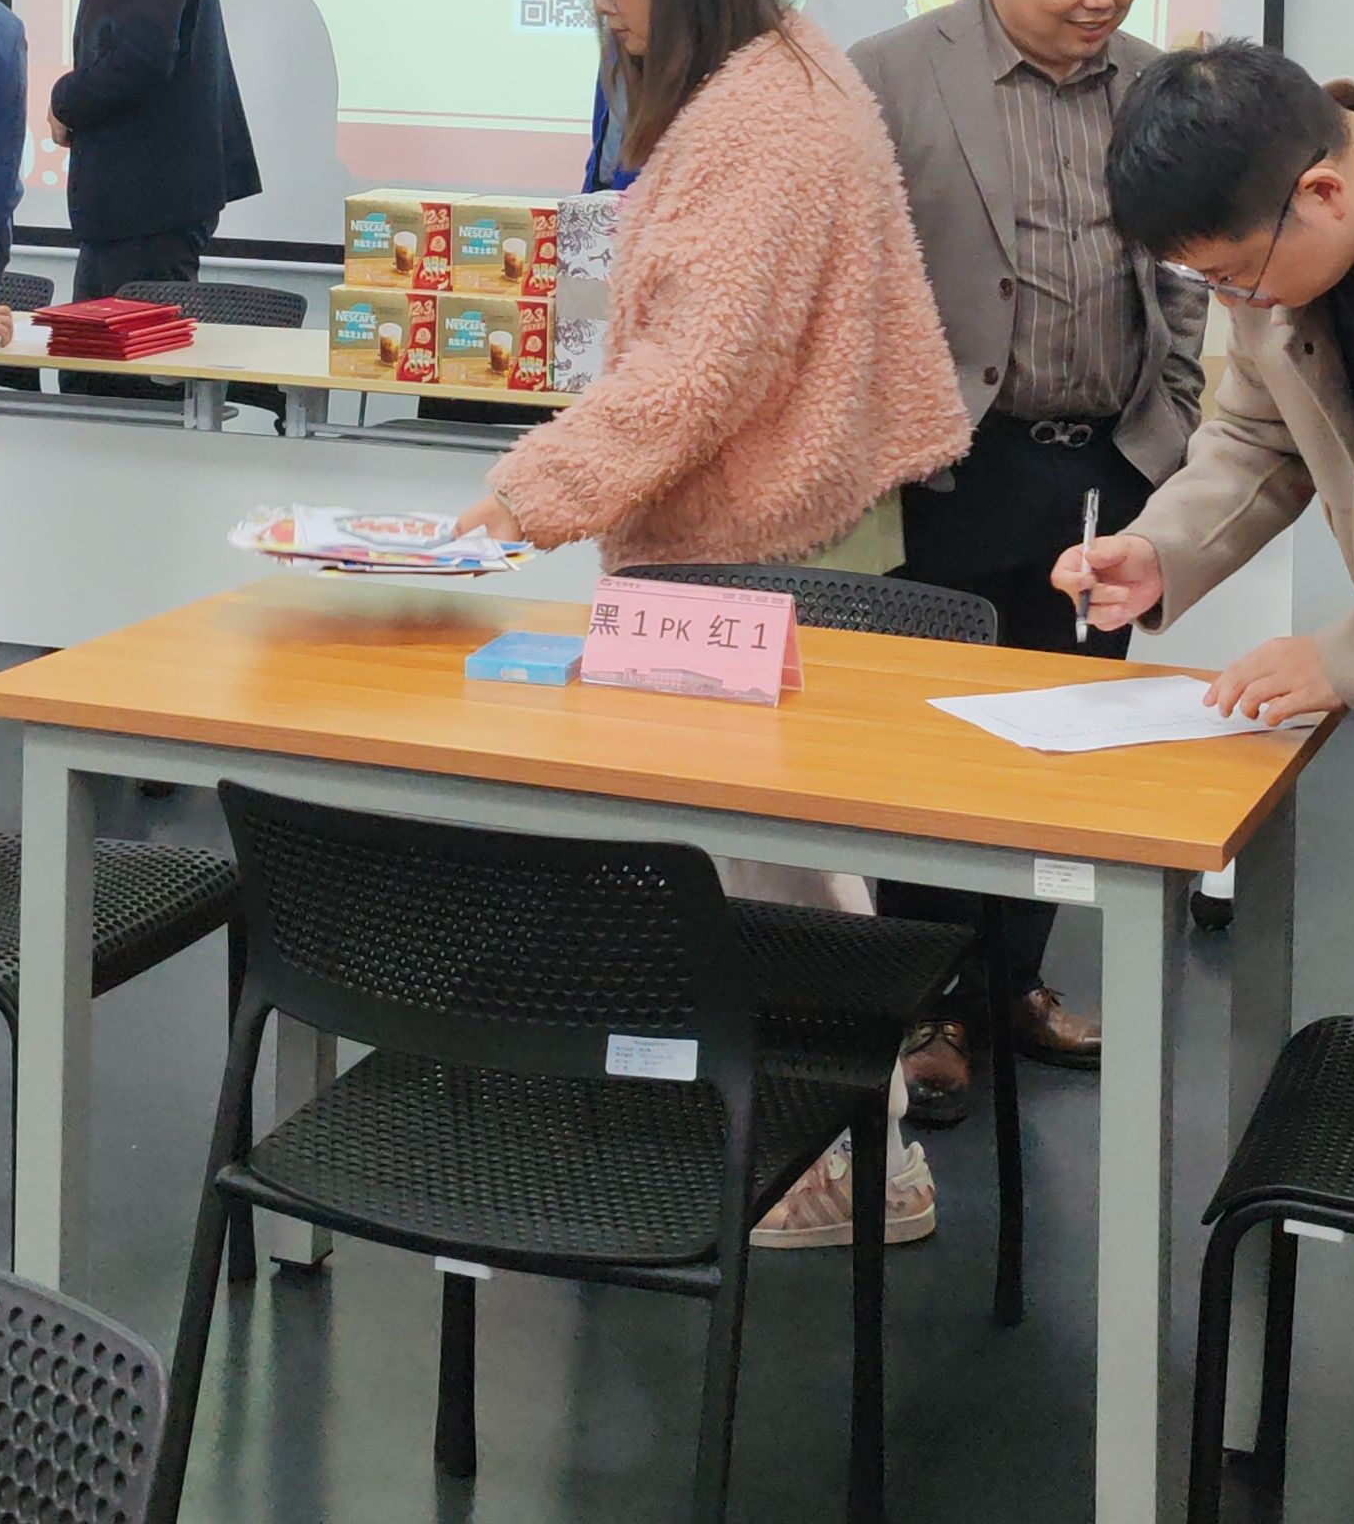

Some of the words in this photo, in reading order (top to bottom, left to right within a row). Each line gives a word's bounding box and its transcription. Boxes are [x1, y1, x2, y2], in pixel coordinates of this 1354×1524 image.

[589, 603, 620, 636] 黑
[631, 610, 648, 637] 1
[659, 617, 693, 642] PK
[707, 614, 741, 649] 红
[751, 622, 768, 649] 1
